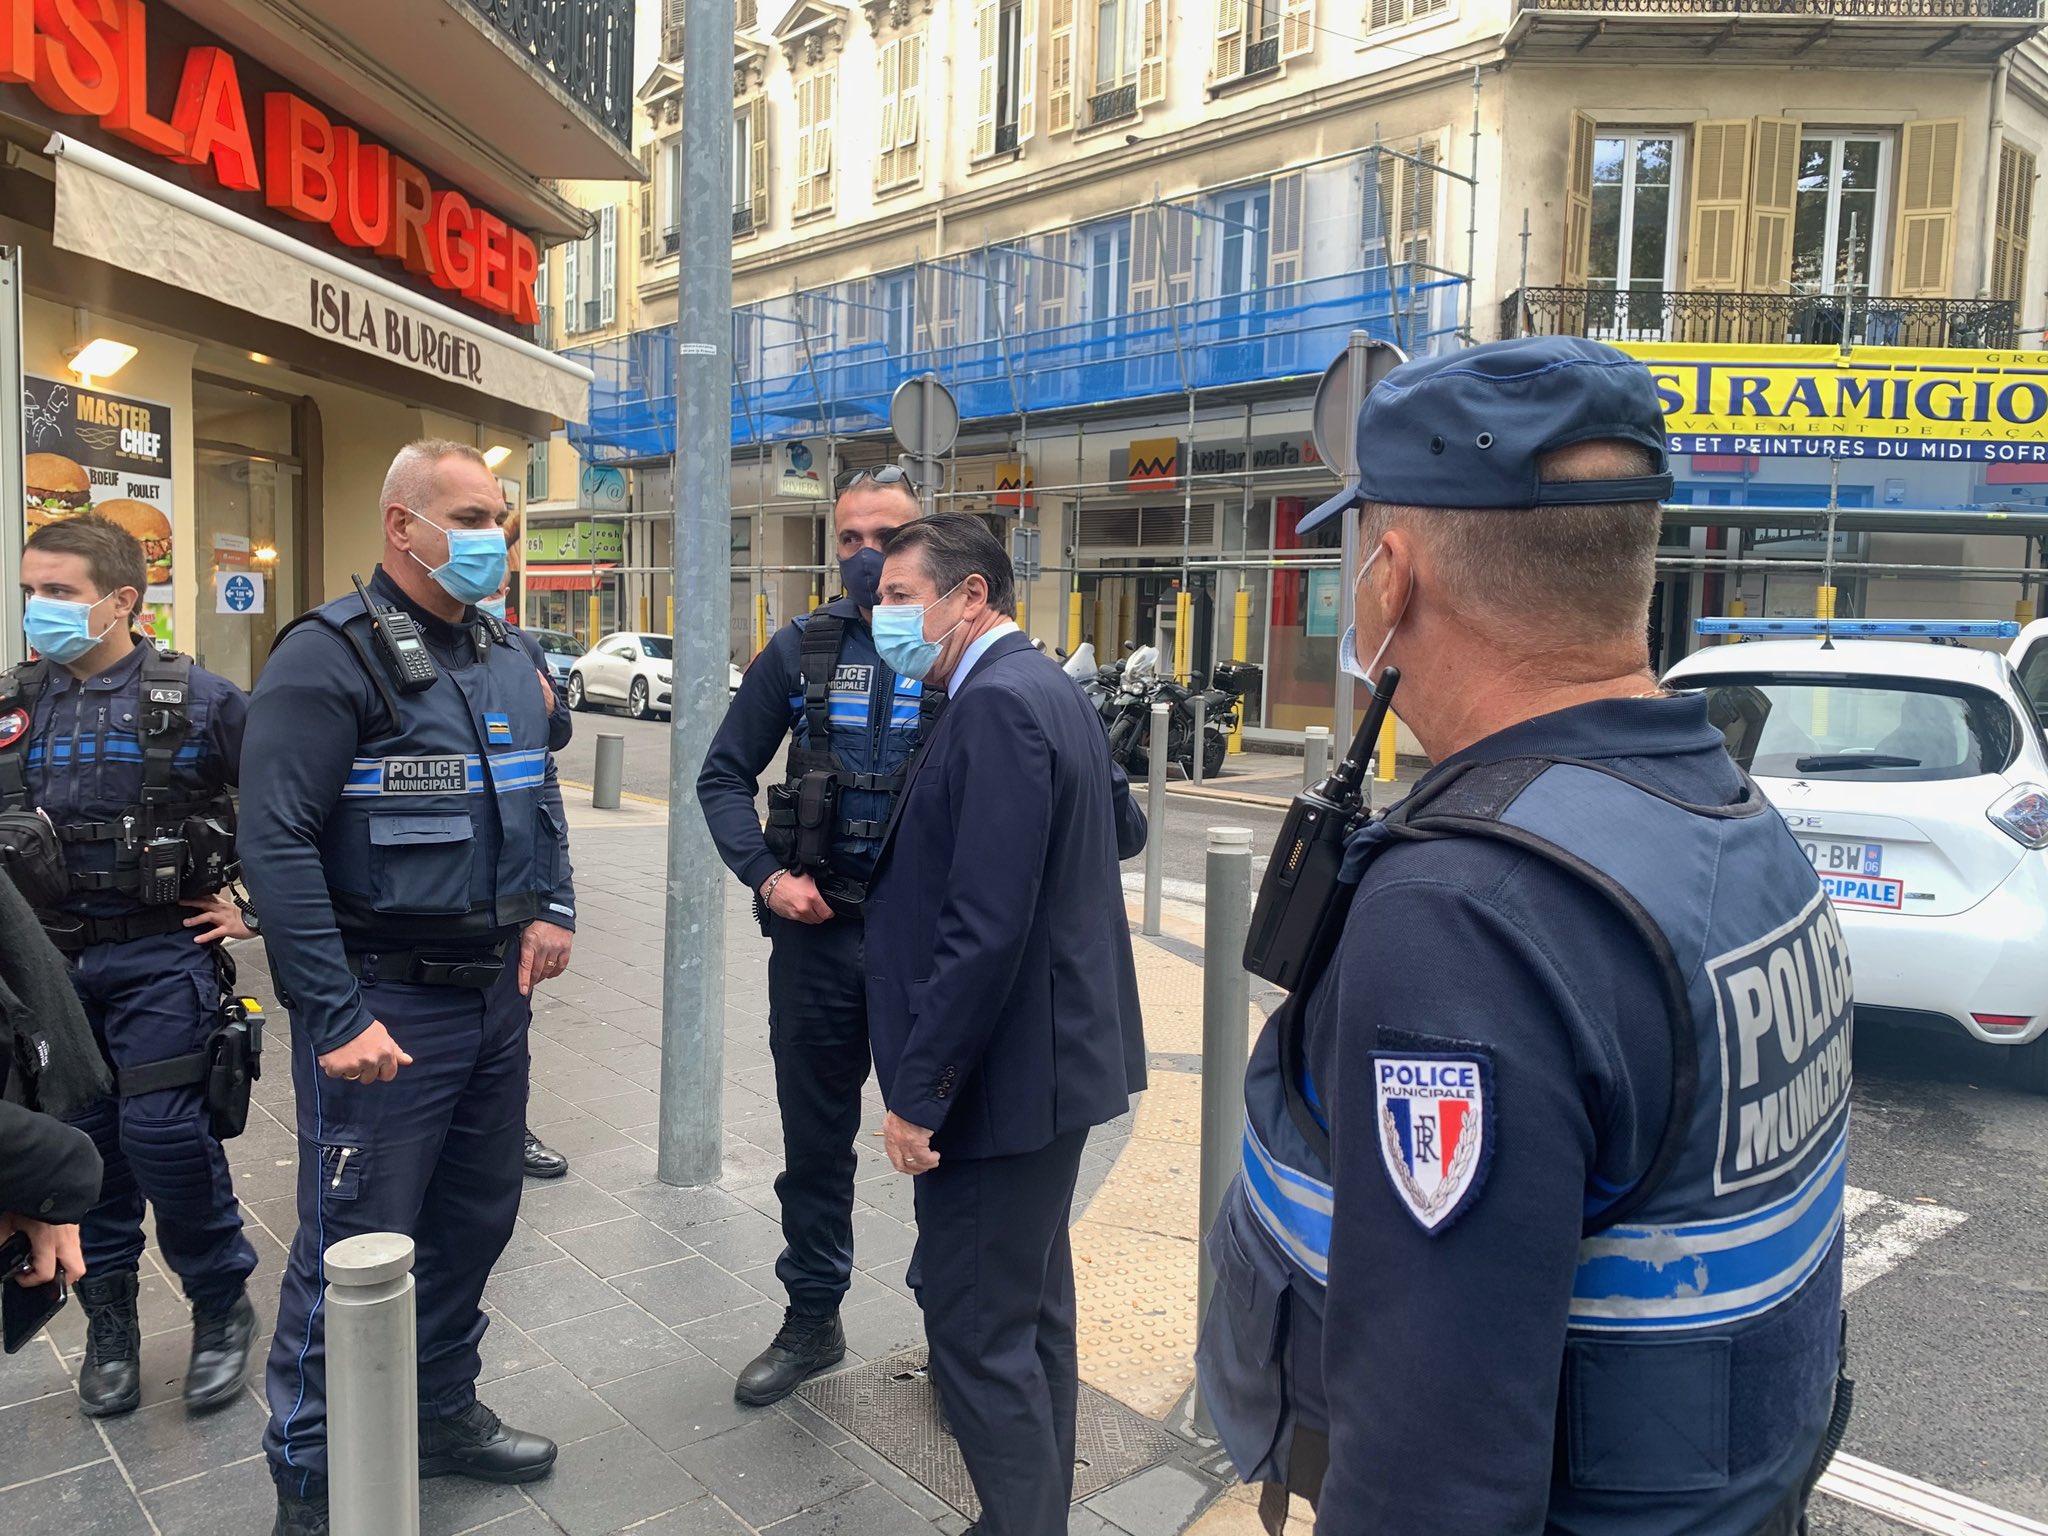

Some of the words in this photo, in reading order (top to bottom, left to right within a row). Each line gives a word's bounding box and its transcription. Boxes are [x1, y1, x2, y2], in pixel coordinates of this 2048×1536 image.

[0, 0, 261, 191] ISLA
[265, 92, 541, 325] BURGER
[310, 277, 379, 349] ISLA
[385, 307, 482, 385] BURGER
[76, 393, 151, 434] MASTER
[1895, 426, 1933, 436] DE
[120, 427, 162, 458] CHEF
[1695, 437, 1721, 453] ET
[1735, 438, 1865, 456] PEINTURES
[1878, 442, 1908, 457] DU
[1922, 443, 1971, 459] MIDI
[89, 469, 119, 486] BOEUF
[127, 482, 160, 499] POULET
[782, 480, 820, 493] RIVIERA
[388, 761, 461, 778] POLICE
[388, 779, 462, 791] MUNICIPALE
[1864, 861, 1879, 873] 06
[1380, 1064, 1475, 1088] POLICE
[1381, 1086, 1475, 1099] MUNICIPALE
